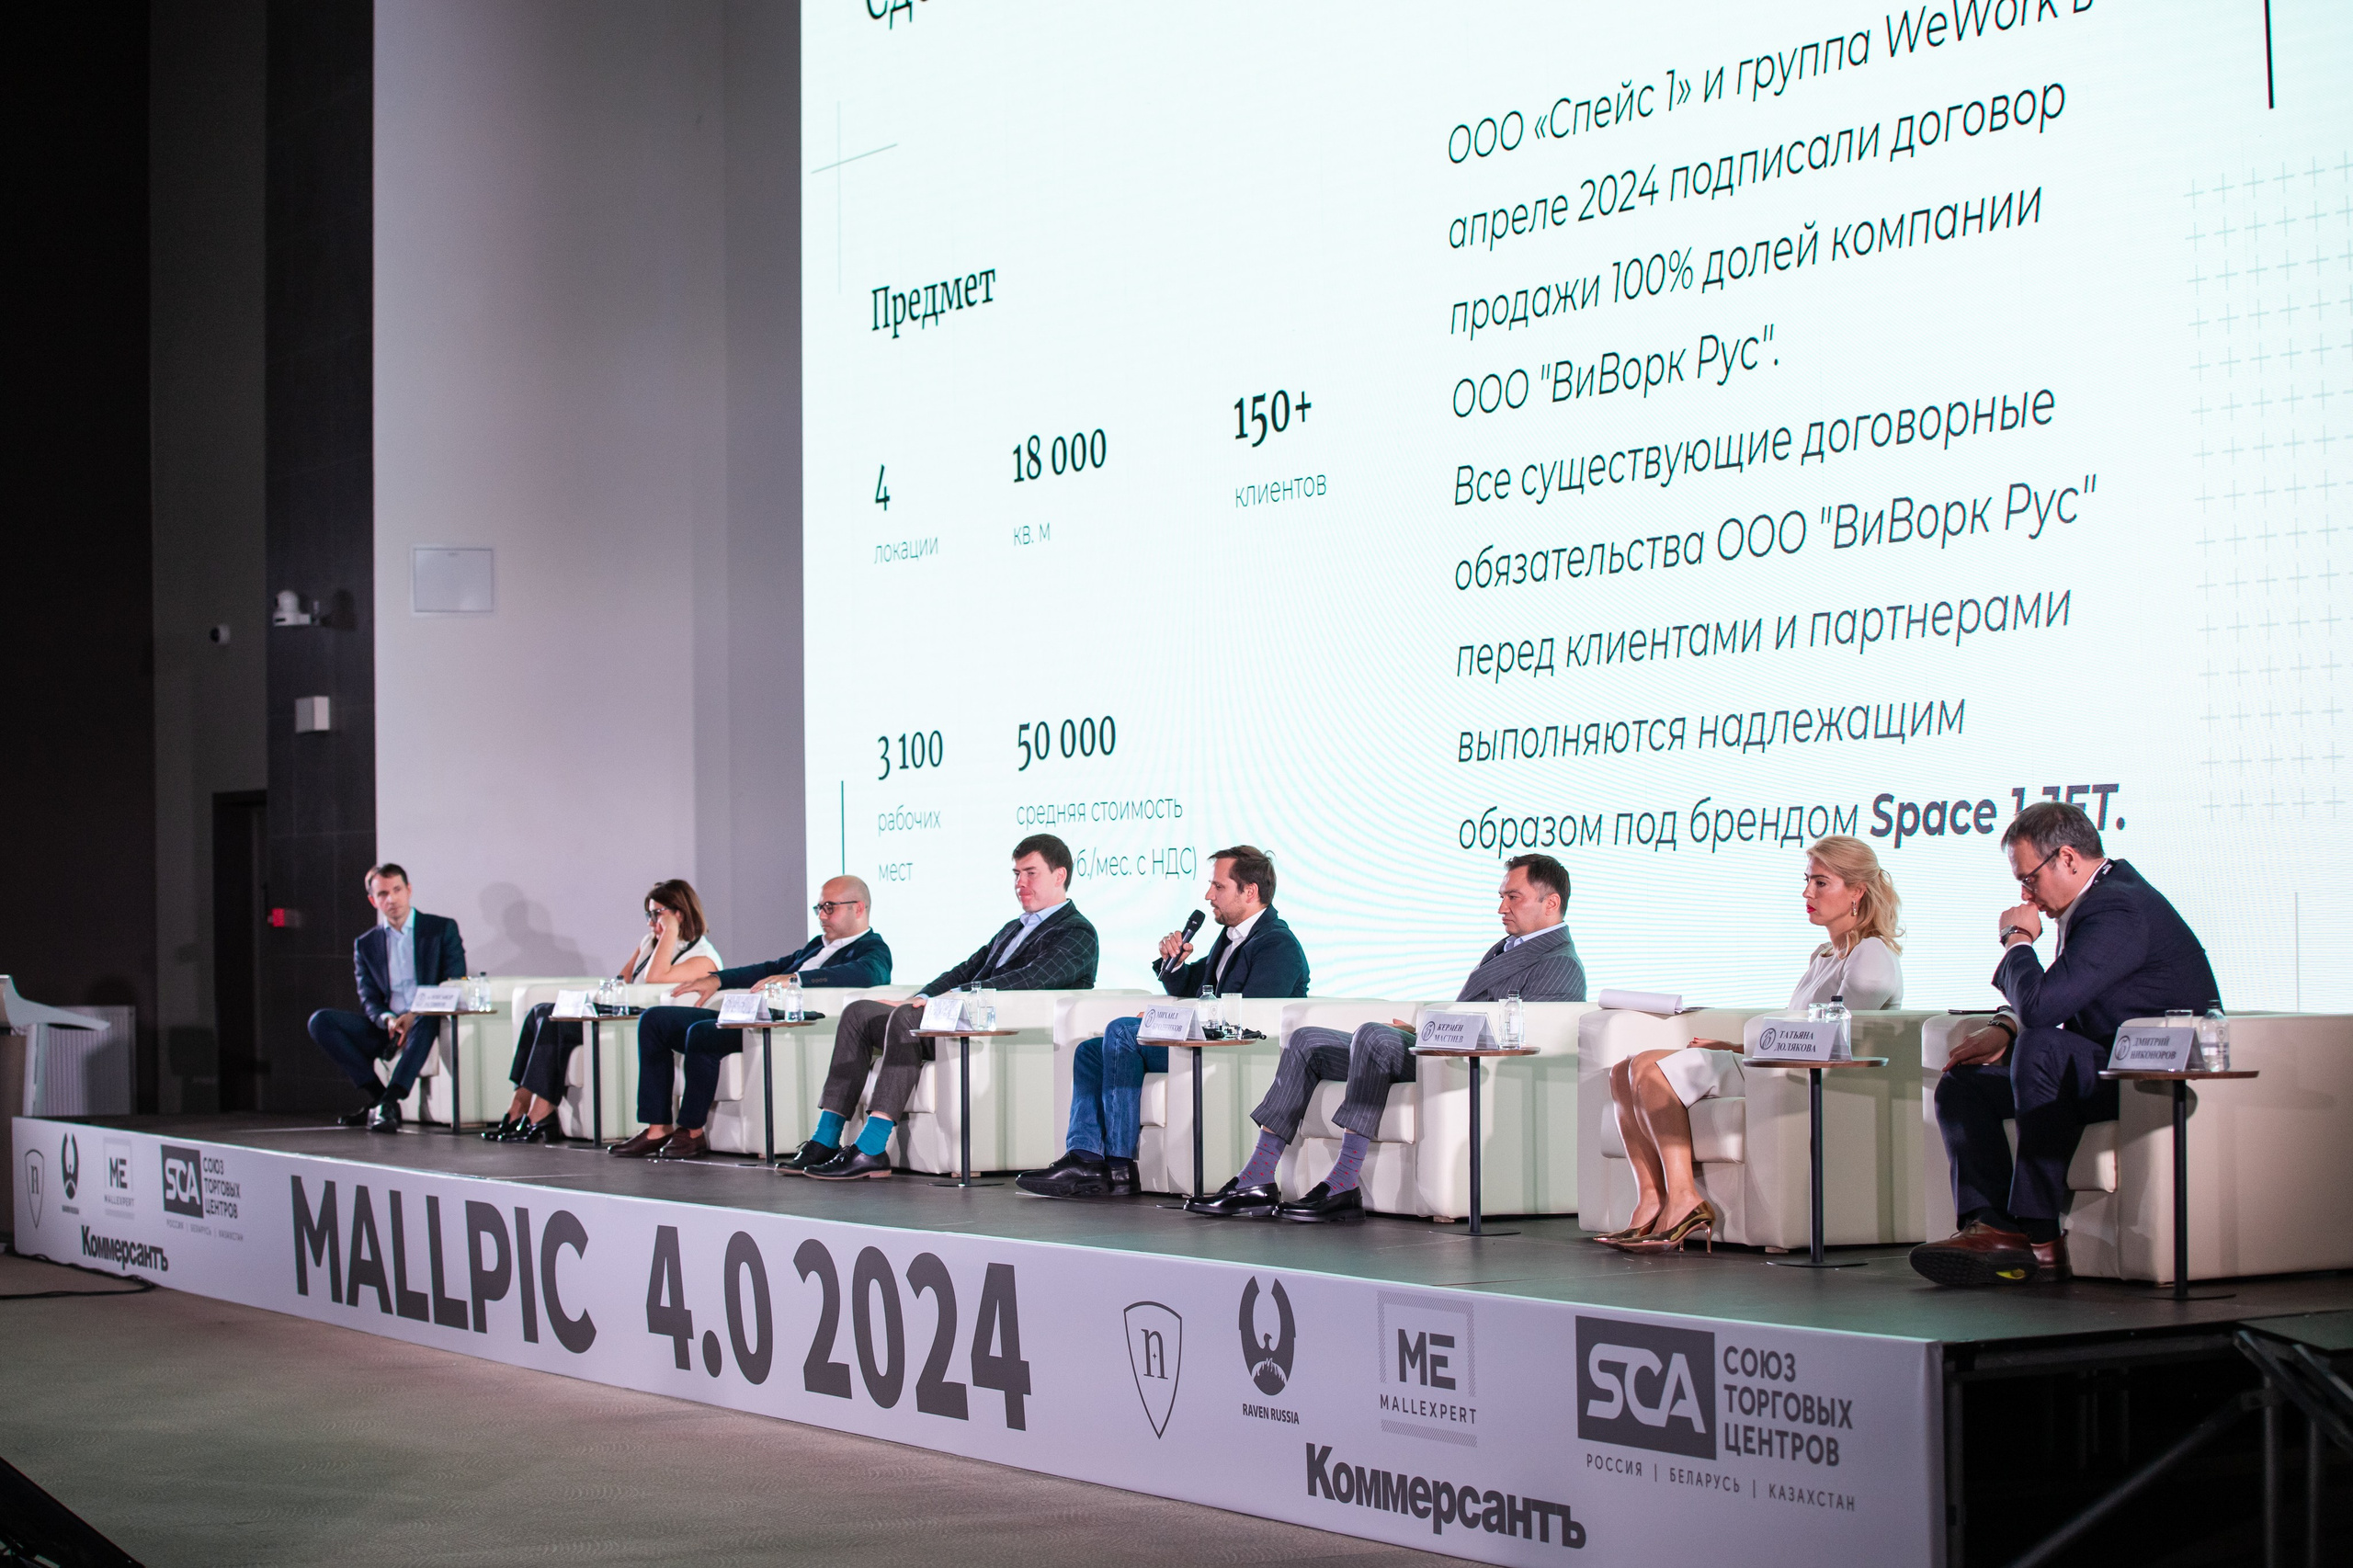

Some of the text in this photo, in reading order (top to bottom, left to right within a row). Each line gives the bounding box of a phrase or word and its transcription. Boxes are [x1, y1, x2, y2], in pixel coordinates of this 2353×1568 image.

[1448, 109, 1525, 165] ООО
[1533, 78, 1655, 140] «Спейс
[1665, 68, 1692, 112] 1»
[1703, 65, 1725, 104] и
[1736, 28, 1871, 103] группа
[1449, 82, 2067, 253] апреле 2024 подписали договор
[1450, 185, 2043, 342] продажи 100% долей компании
[870, 267, 996, 340] Предмет
[1452, 323, 1779, 419] ООО "ВиВорк Рус".
[1233, 388, 1313, 449] 150+
[1012, 427, 1108, 483] 18 000
[1454, 388, 2056, 506] Все существующие договорные
[874, 463, 892, 512] 4
[1235, 473, 1327, 508] клиентов
[874, 537, 938, 564] локации
[1014, 522, 1051, 546] кв. м
[1454, 472, 2097, 591] обязательства ООО "ВиВорк Рус"
[1456, 588, 2073, 685] перед клиентами и партнерами
[1458, 698, 1967, 764] выполняются надлежащим
[878, 804, 941, 837] рабочих
[1016, 797, 1184, 831] средняя стоимость
[1459, 805, 1604, 860] образом
[1613, 810, 1678, 853] под
[1689, 795, 1859, 855] брендом
[1869, 792, 1998, 849] Space
[878, 860, 914, 882] мест
[1136, 855, 1147, 876] с
[1151, 846, 1198, 881] НДС)
[1437, 1023, 1464, 1032] КЕРМЕН
[1774, 1043, 1816, 1053] ДОЛЯКОВА
[1779, 1030, 1814, 1040] ТАТЬЯНА
[2132, 1035, 2170, 1047] ДМИТРИЙ
[2130, 1050, 2177, 1061] НИКОНОРОВ
[108, 1157, 128, 1189] ME
[165, 1157, 201, 1206] SCA
[203, 1156, 224, 1175] СОЮЗ
[204, 1178, 241, 1199] ТОРГОВЫХ
[205, 1199, 238, 1219] ЦЕНТРОВ
[81, 1224, 169, 1272] Коммерсантъ
[290, 1175, 1032, 1432] MALLPIC 4.0 2024
[1397, 1328, 1457, 1391] ME
[1722, 1345, 1797, 1383] СОЮЗ
[1380, 1393, 1478, 1426] MALLEXPERT
[1586, 1342, 1708, 1435] SCA
[1723, 1383, 1854, 1430] ТОРГОВЫХ
[1243, 1403, 1300, 1426] RAVEN RUSSIA
[1723, 1422, 1840, 1468] ЦЕНТРОВ
[1305, 1441, 1587, 1550] Коммерсантъ
[1586, 1453, 1856, 1512] РОССИЯ БЕЛАРУСЬ КАЗАХСТАН
